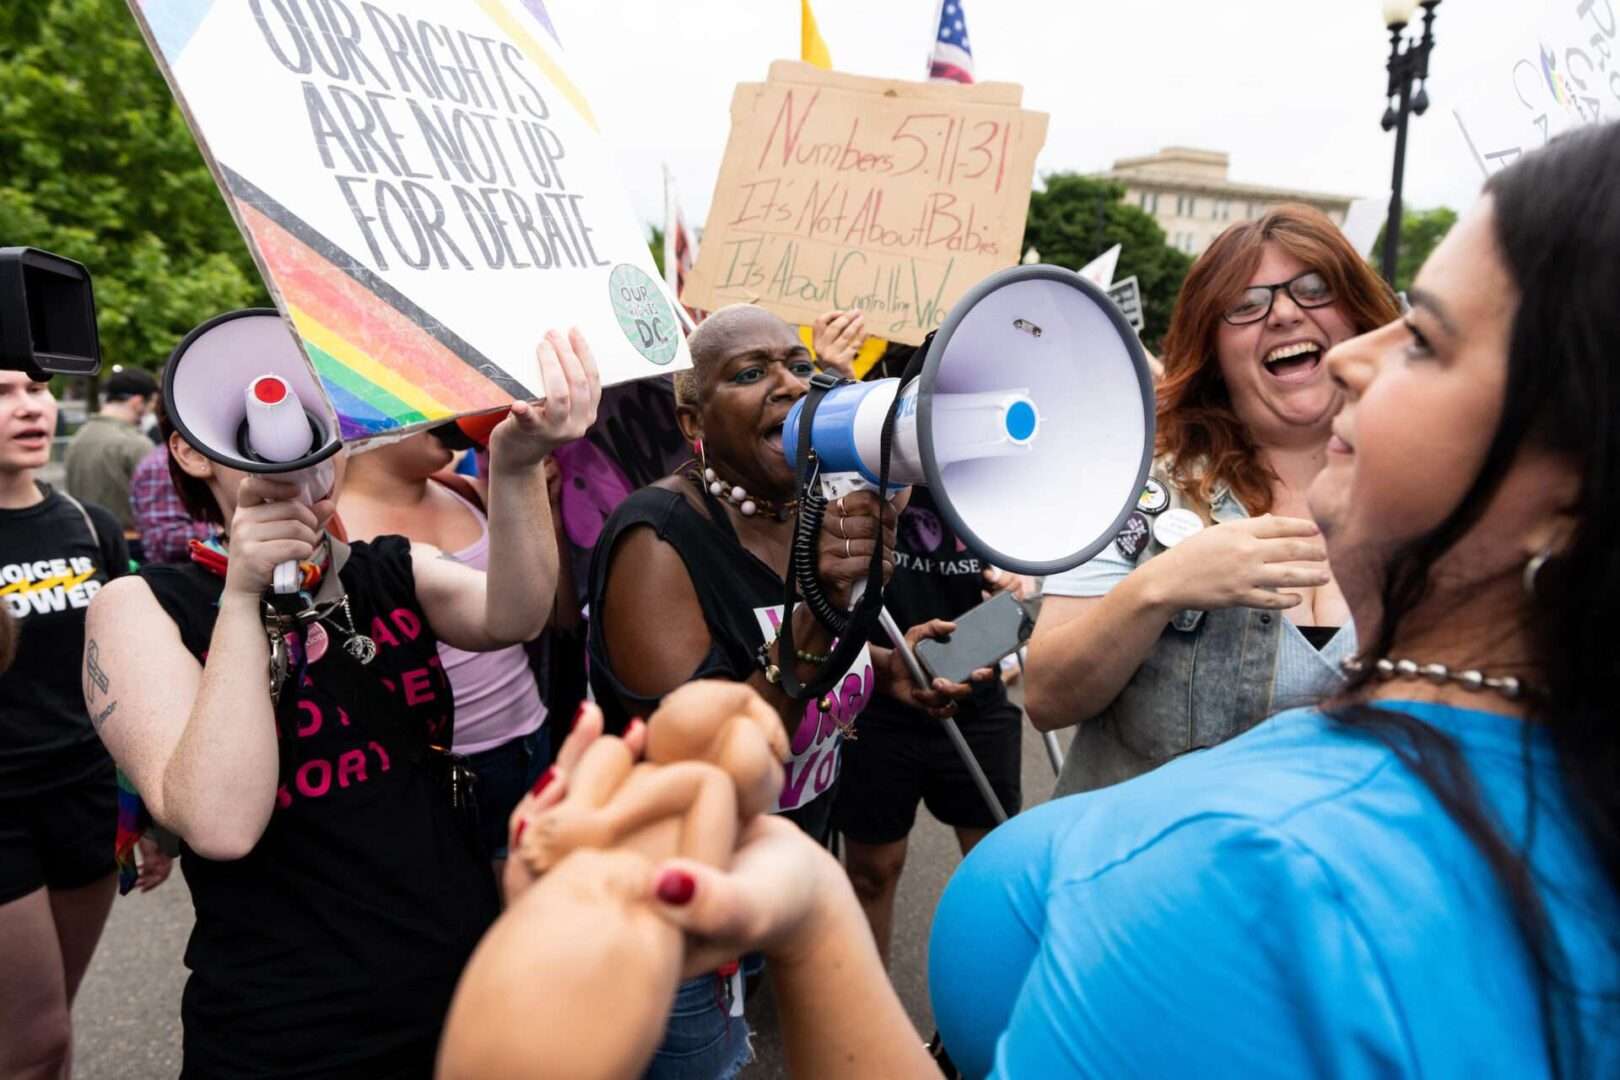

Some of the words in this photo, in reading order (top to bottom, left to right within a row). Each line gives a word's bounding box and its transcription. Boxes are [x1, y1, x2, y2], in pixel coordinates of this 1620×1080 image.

[247, 0, 391, 91] OUR
[361, 0, 550, 120] RIGHTS
[300, 81, 434, 180] ARE
[406, 98, 516, 188] NOT
[506, 117, 566, 191] UP
[758, 88, 894, 172] Numbers
[334, 174, 475, 271] FOR
[451, 183, 612, 271] DEBATE
[727, 177, 796, 227] It's
[794, 179, 848, 239] Not
[844, 186, 928, 248] About
[924, 191, 1000, 256] Babies
[766, 239, 837, 300] About
[832, 249, 911, 333] Controlling
[634, 316, 669, 348] DC
[0, 557, 67, 588] OICE
